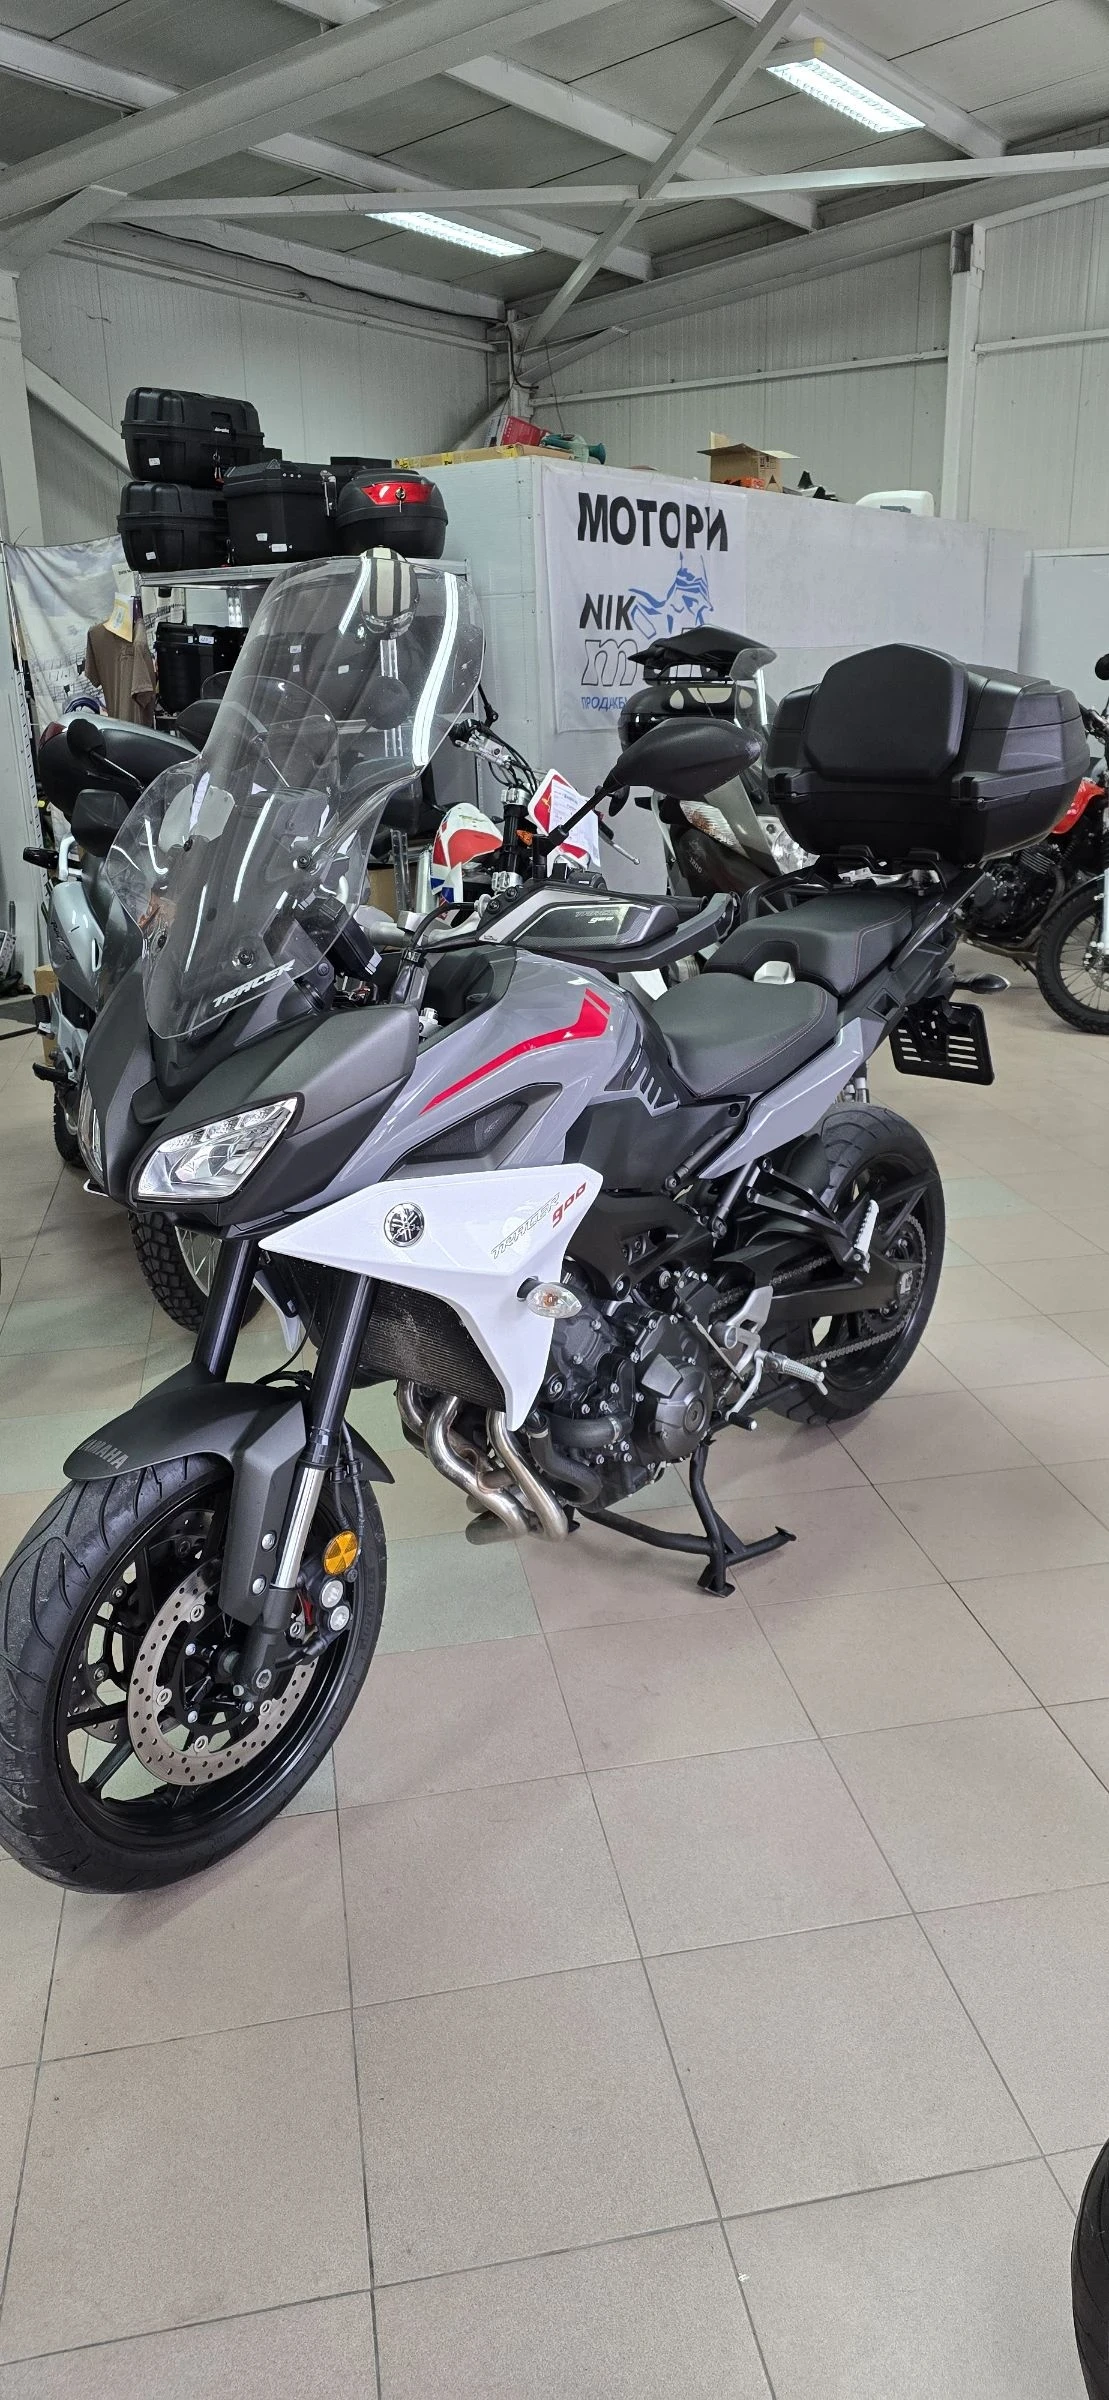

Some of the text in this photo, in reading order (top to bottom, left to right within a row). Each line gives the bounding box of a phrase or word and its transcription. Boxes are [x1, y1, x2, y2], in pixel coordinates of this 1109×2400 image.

[577, 492, 729, 552] МОТОРИ
[579, 593, 635, 631] NIK
[587, 916, 615, 924] 900
[212, 958, 296, 1008] TRACER
[490, 1182, 587, 1260] TRACER 900
